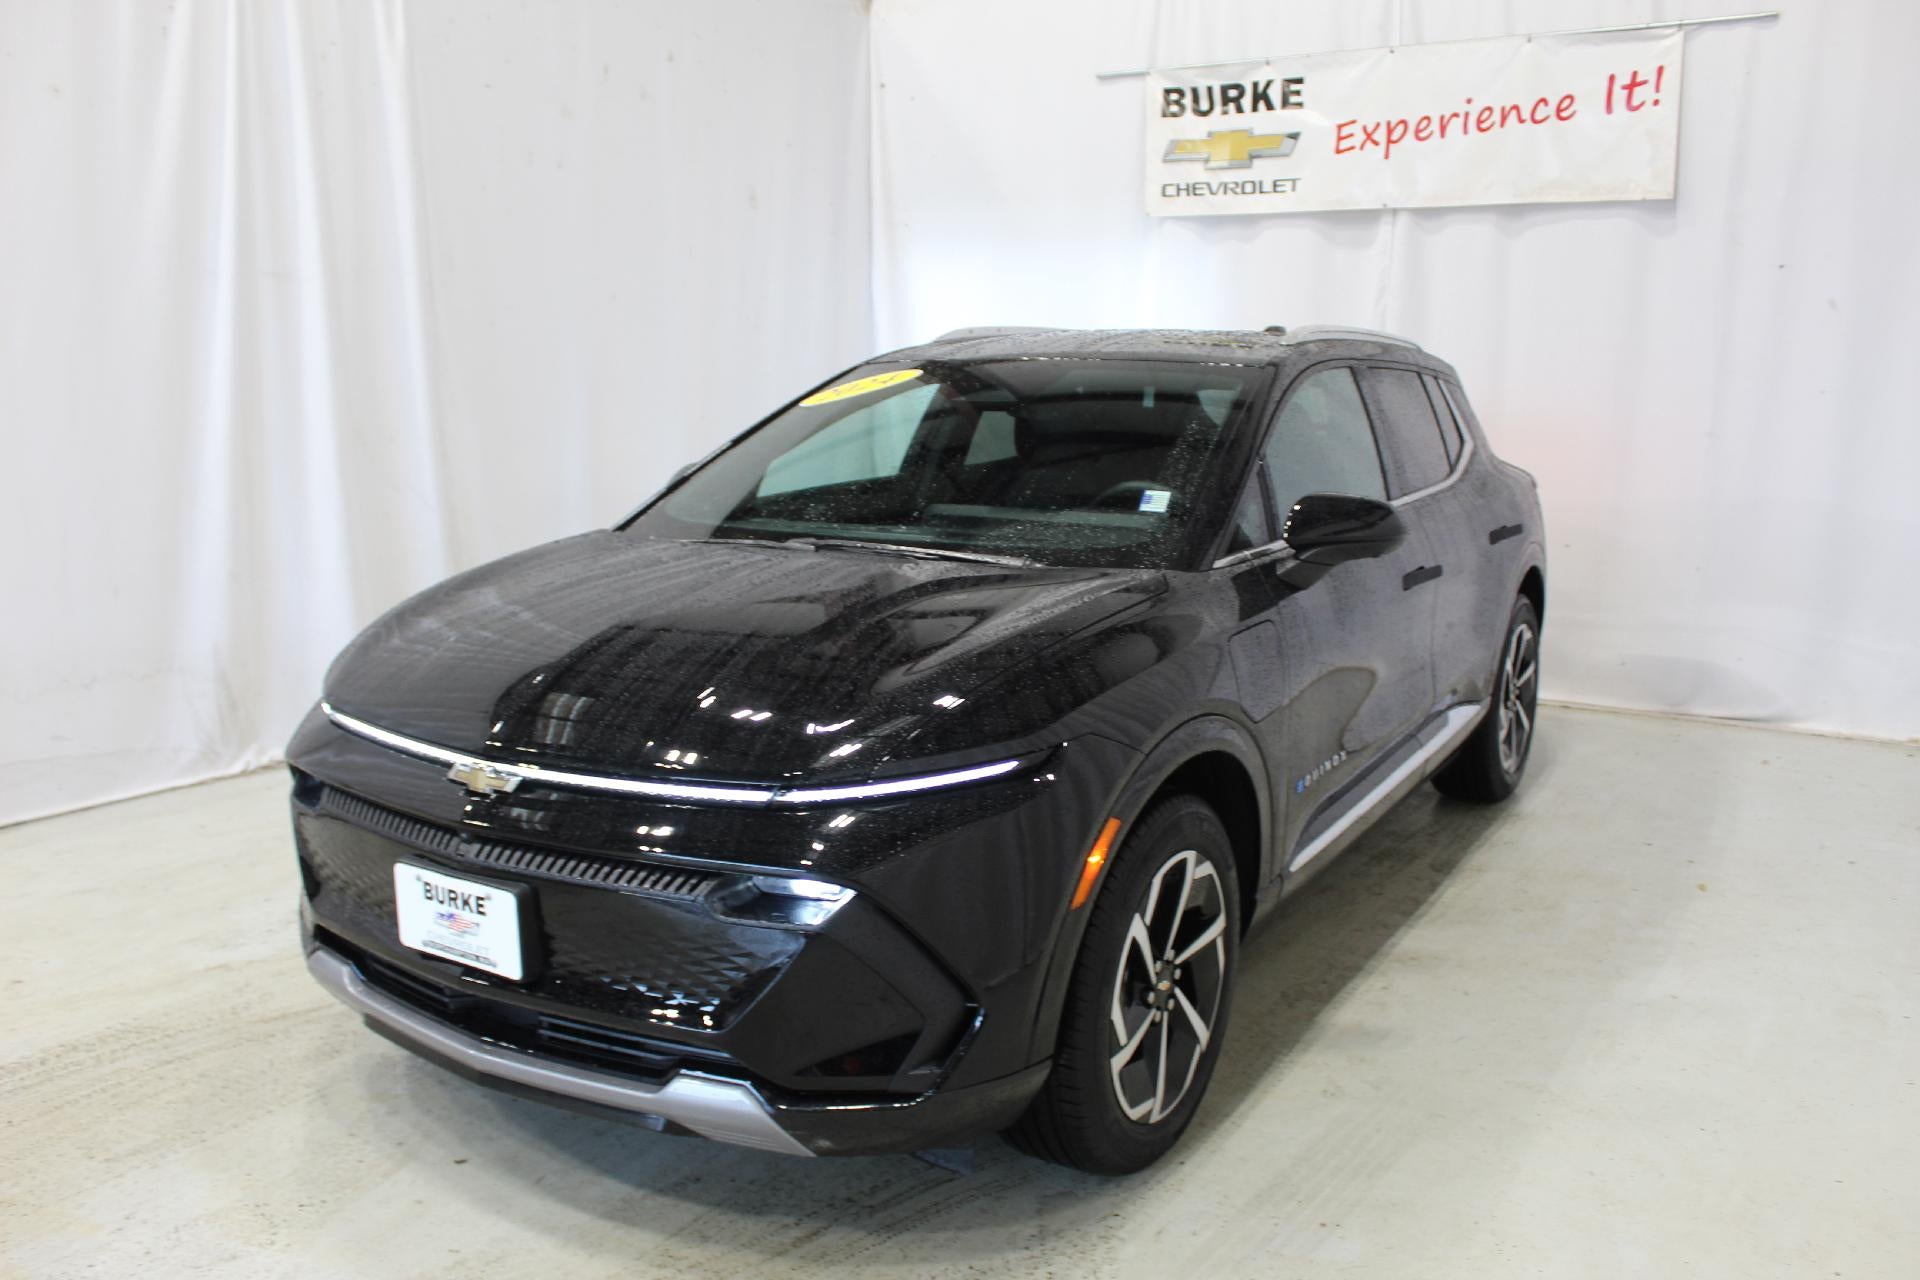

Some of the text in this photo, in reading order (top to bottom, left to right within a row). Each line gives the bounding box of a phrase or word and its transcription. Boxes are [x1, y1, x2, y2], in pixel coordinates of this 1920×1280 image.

[1160, 76, 1305, 118] BURKE
[1334, 64, 1665, 160] Experience It!
[1161, 177, 1302, 198] CHEVROLET
[423, 881, 487, 916] BURKE
